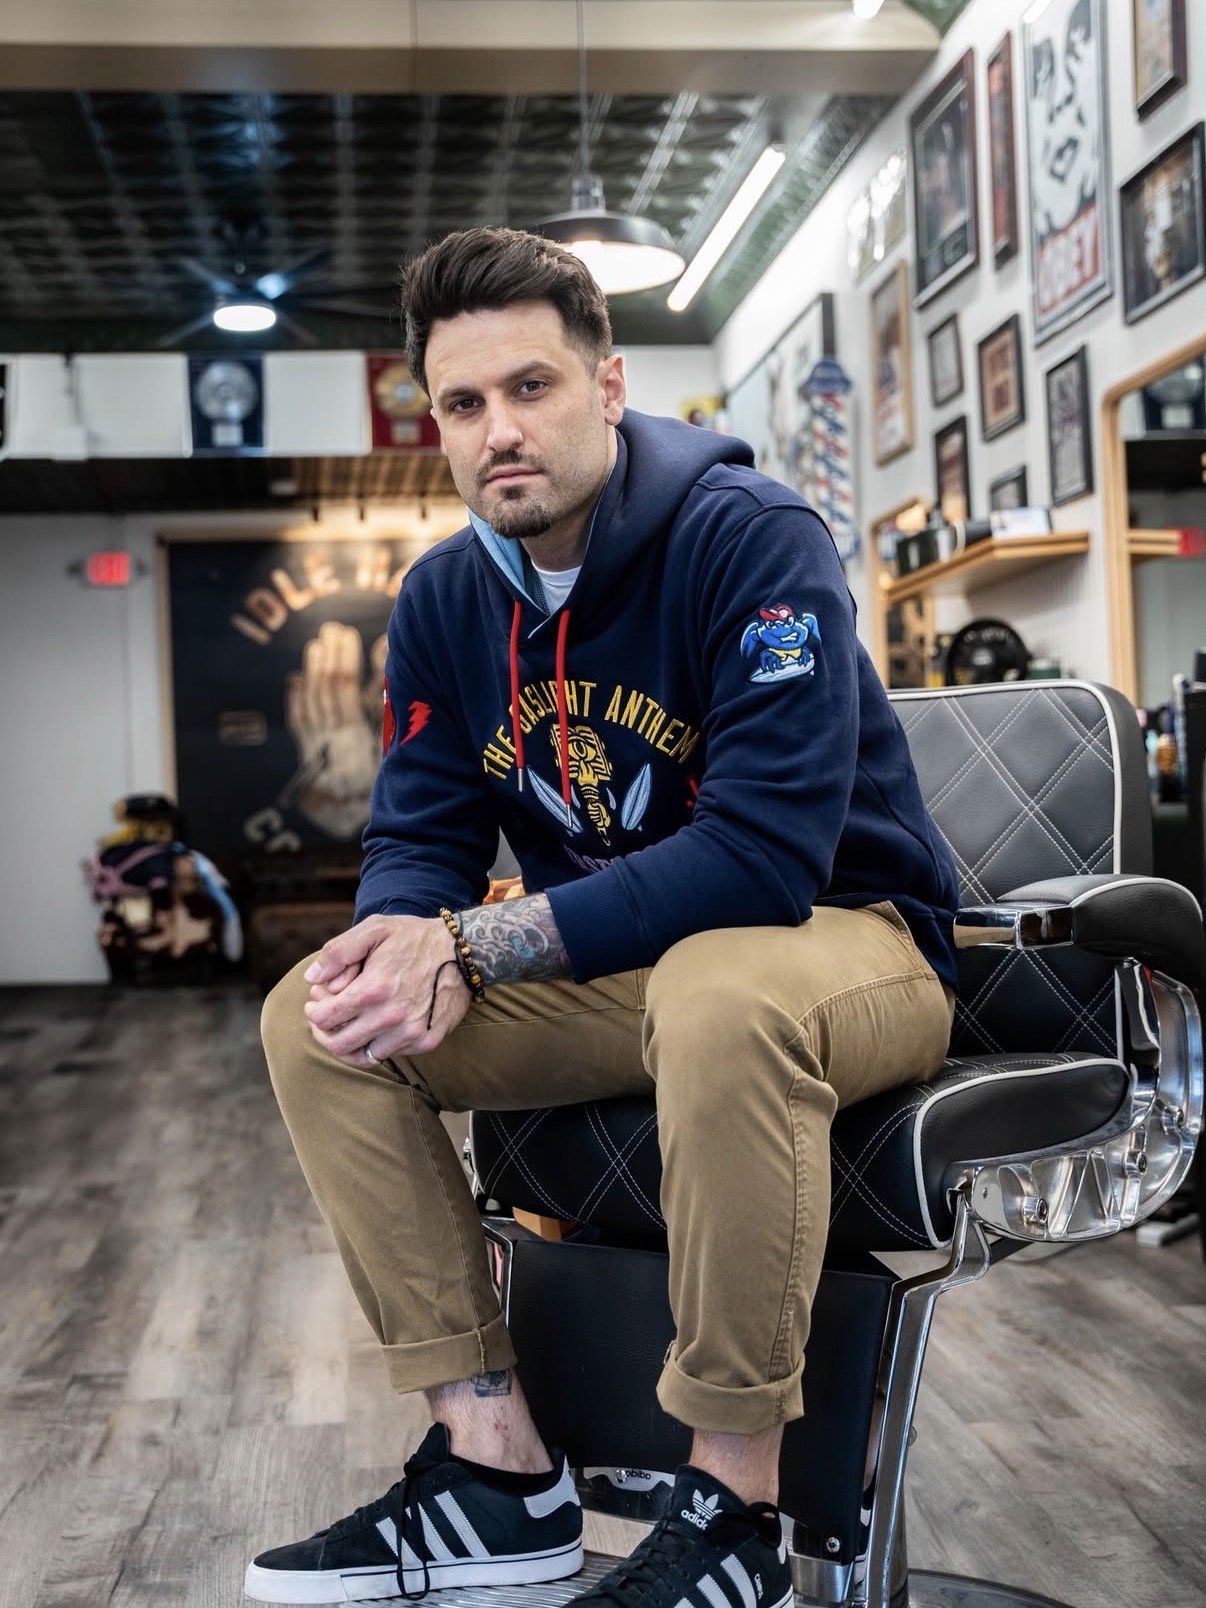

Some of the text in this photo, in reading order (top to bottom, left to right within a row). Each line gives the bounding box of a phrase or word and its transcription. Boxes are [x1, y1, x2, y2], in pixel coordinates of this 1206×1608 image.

[230, 553, 341, 645] IDLE
[483, 724, 517, 780] THE
[604, 684, 700, 764] ANTHEM
[681, 1509, 708, 1530] adid
